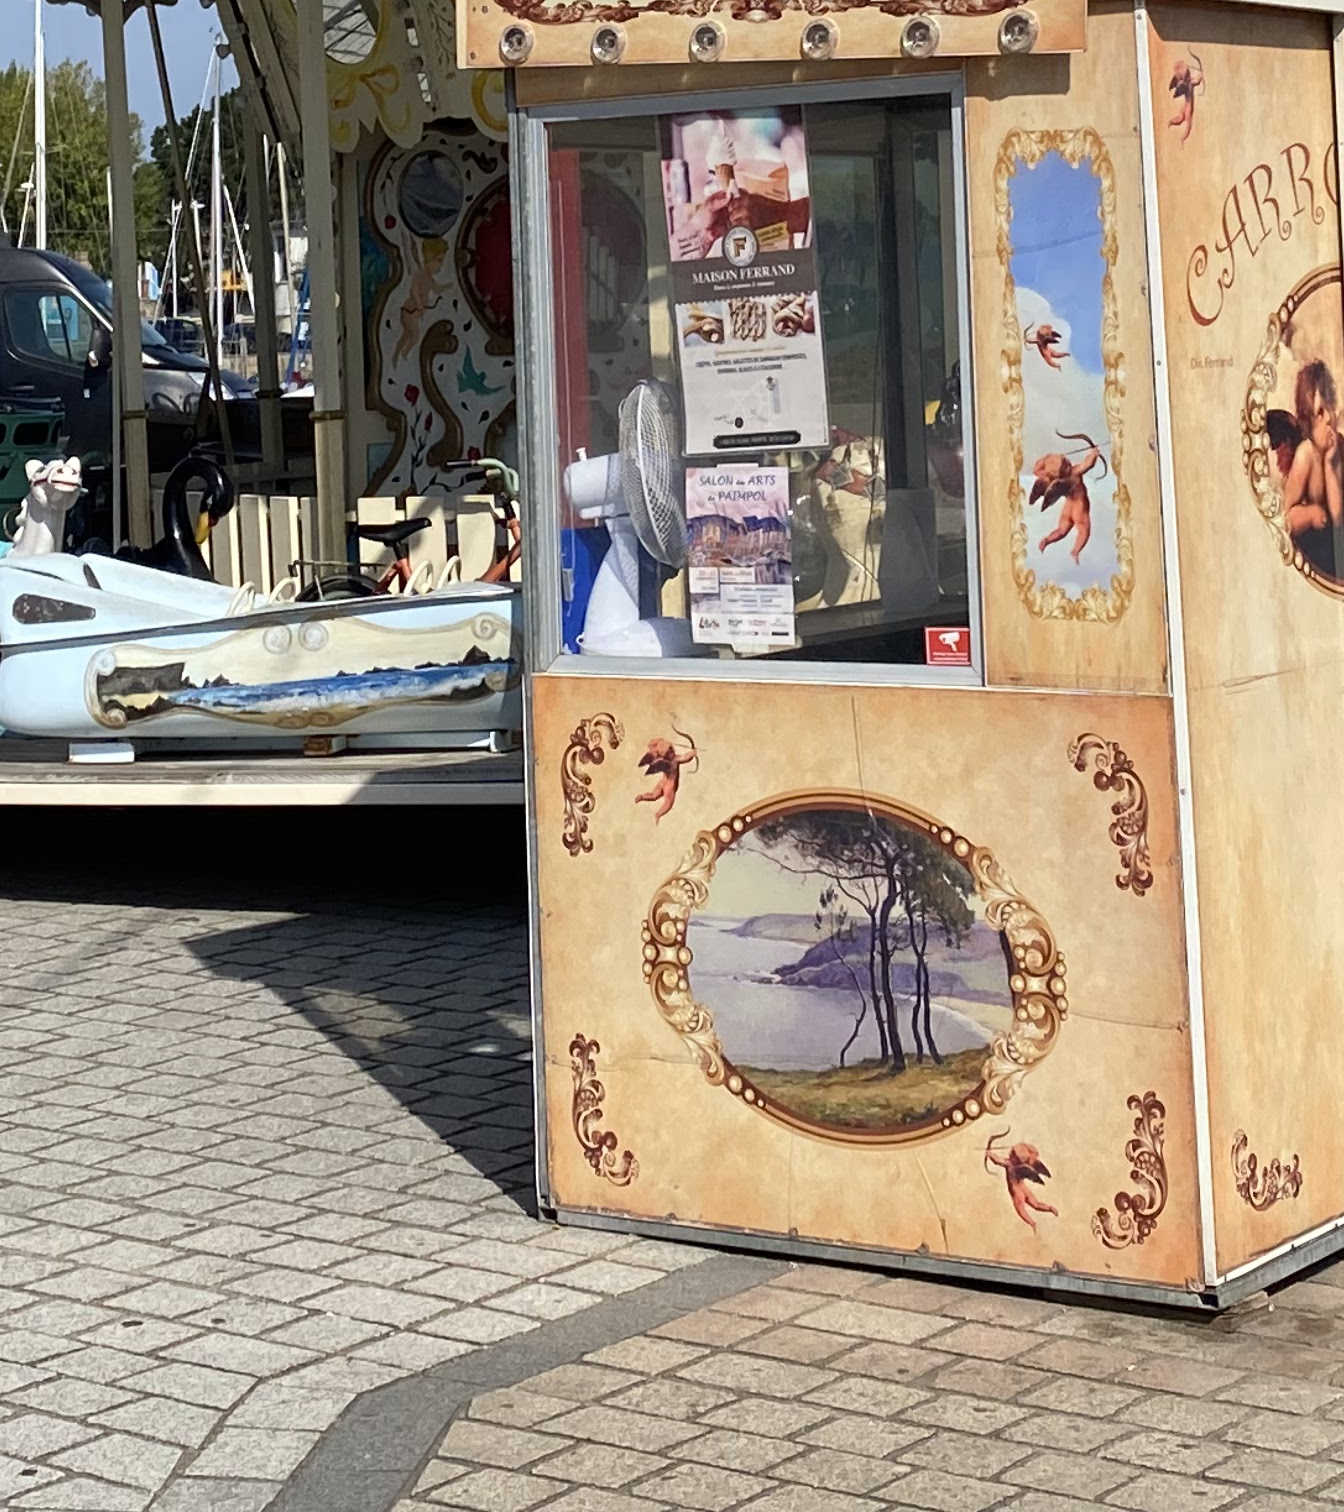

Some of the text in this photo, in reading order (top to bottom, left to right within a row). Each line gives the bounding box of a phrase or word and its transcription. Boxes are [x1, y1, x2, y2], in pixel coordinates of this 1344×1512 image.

[733, 235, 747, 258] F
[692, 263, 796, 284] MAISON FERRAND
[699, 475, 734, 486] SALON
[748, 474, 777, 486] ARTS
[718, 490, 768, 502] PAIMPOL
